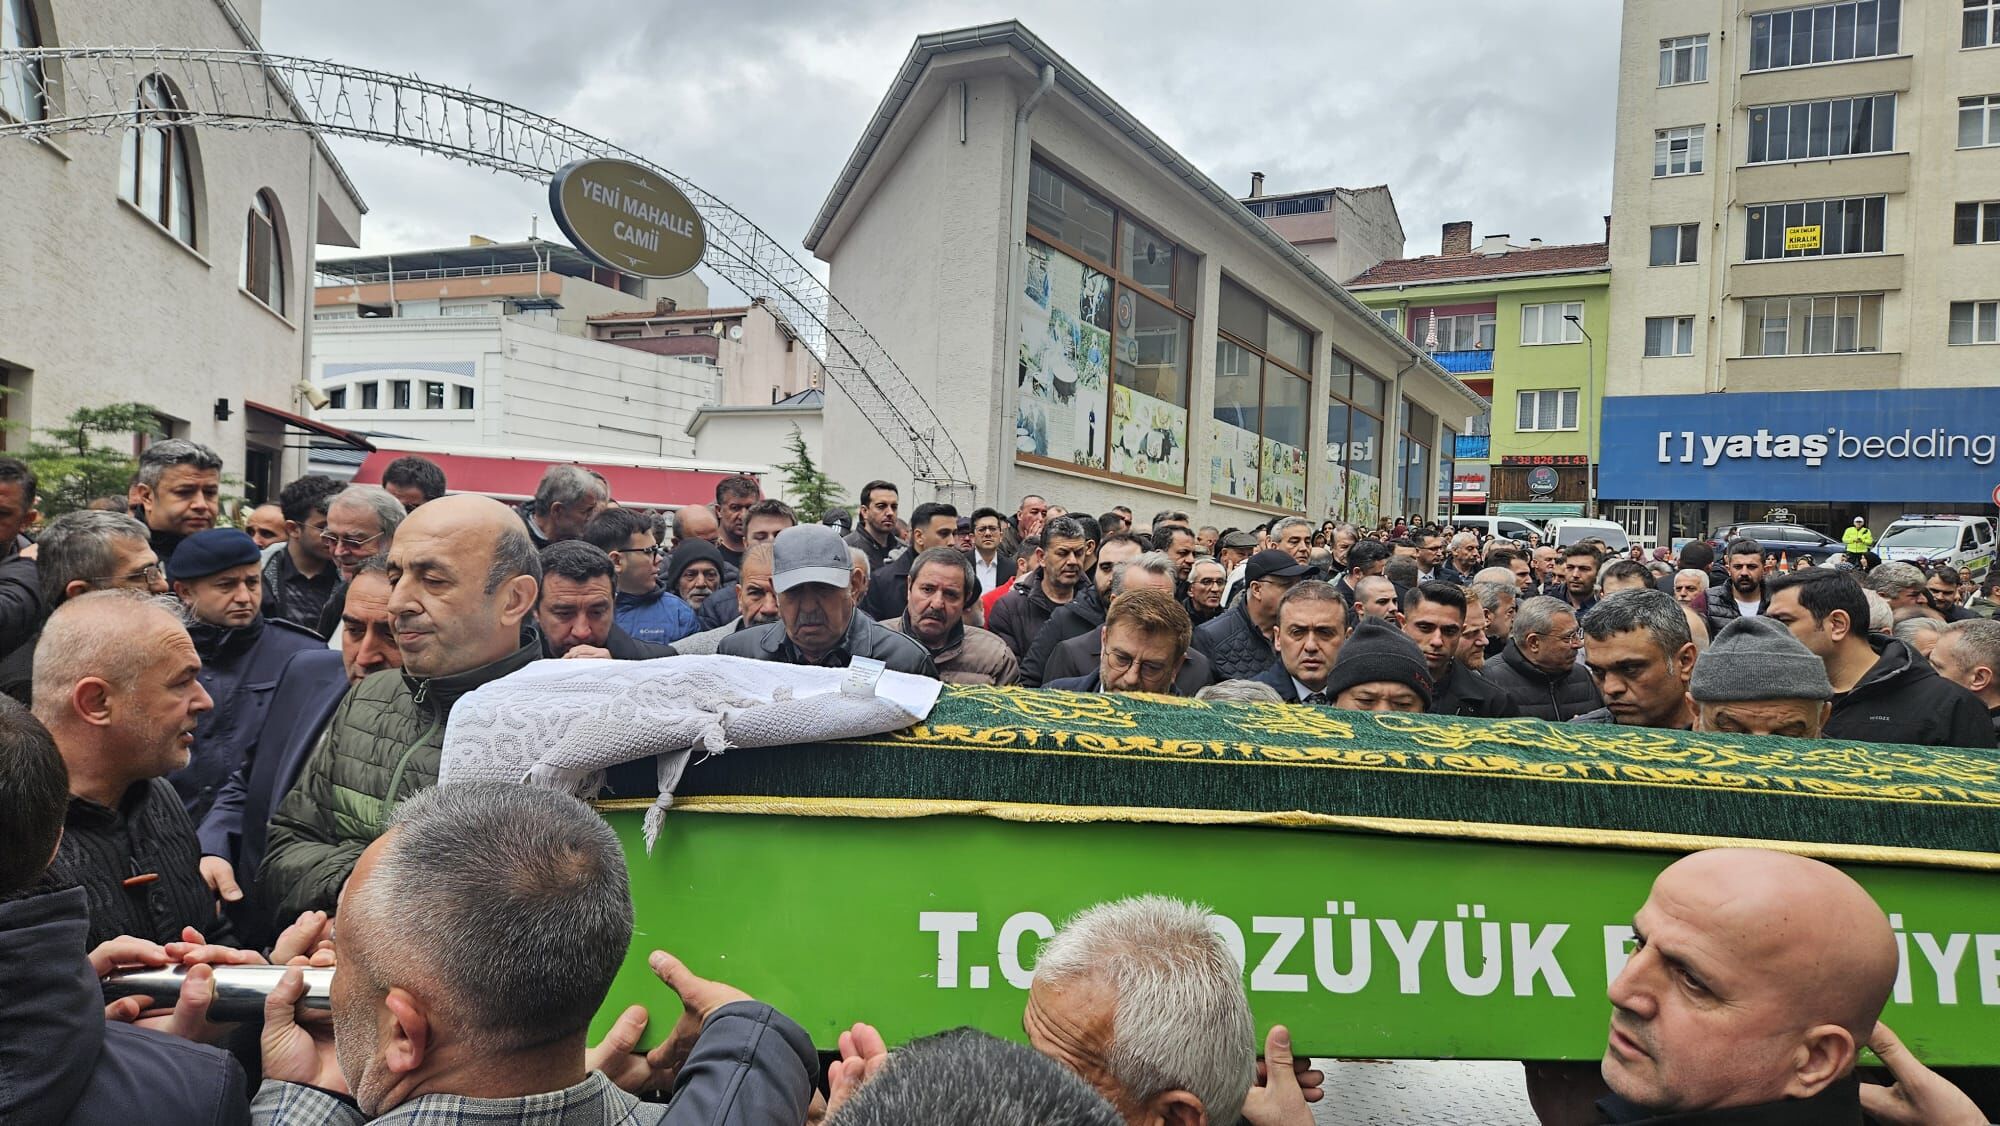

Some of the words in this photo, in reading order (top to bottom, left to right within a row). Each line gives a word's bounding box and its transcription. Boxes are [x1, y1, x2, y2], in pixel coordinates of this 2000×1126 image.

[582, 177, 620, 209] YENİ
[623, 195, 694, 239] MAHALLE
[613, 221, 660, 252] CAMİİ
[1790, 236, 1817, 244] KİRALIK
[1701, 429, 1829, 466] yataş
[1837, 429, 1997, 465] bedding
